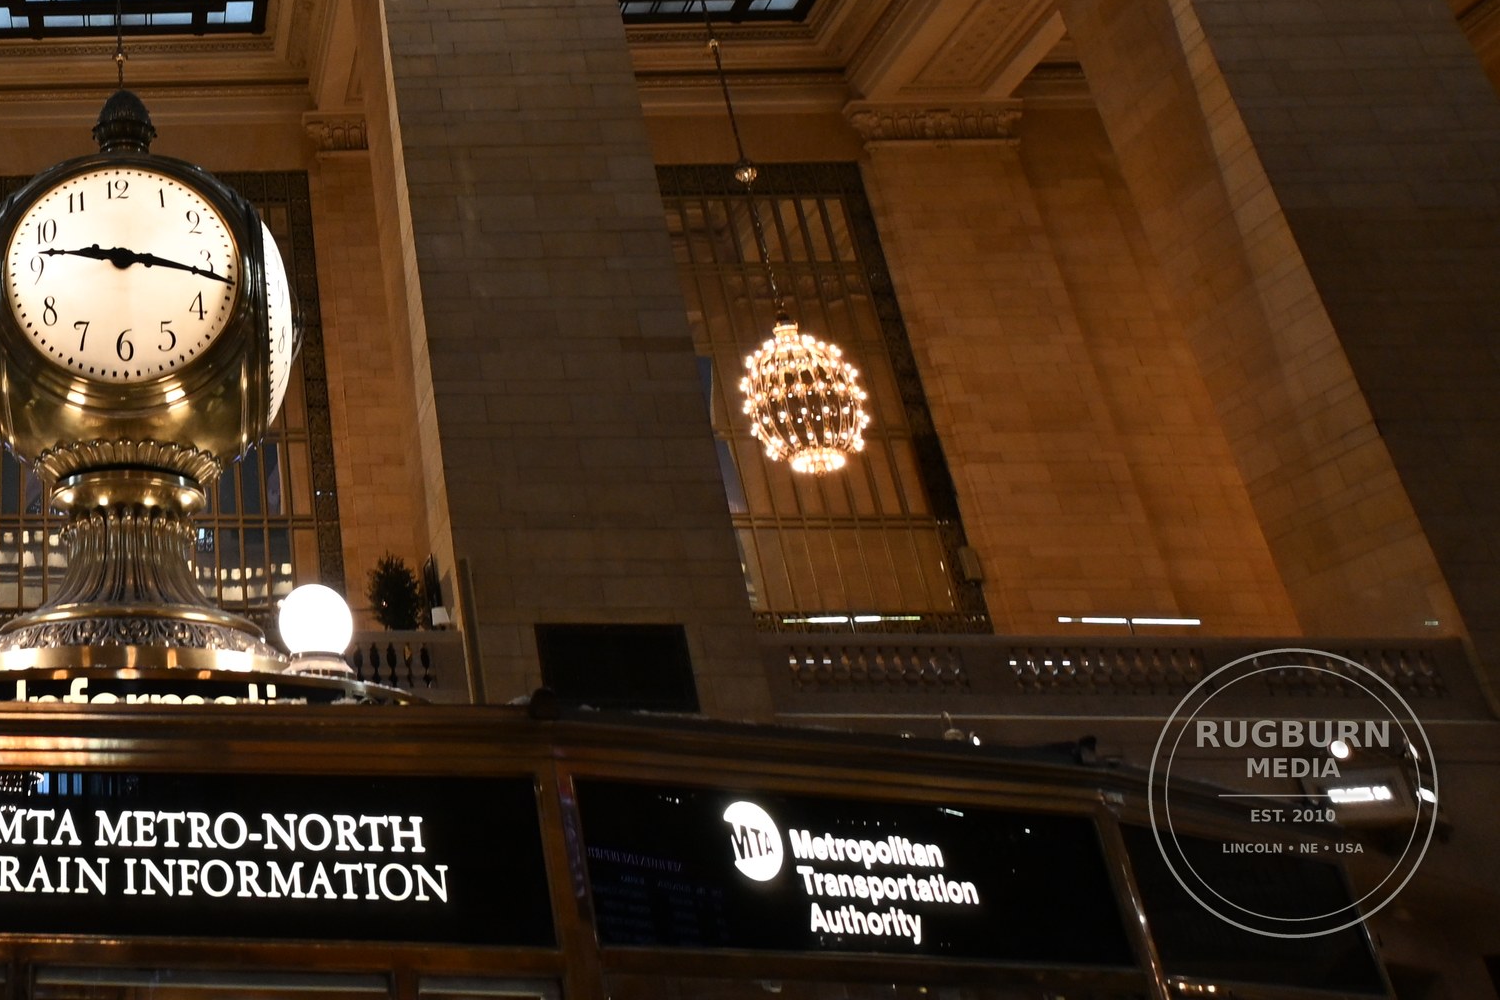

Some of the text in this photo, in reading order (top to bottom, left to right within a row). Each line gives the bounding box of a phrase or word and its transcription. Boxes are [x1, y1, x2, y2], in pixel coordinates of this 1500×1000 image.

[67, 191, 85, 213] 11
[106, 179, 129, 199] 12
[158, 188, 165, 208] 1
[37, 219, 57, 245] 10
[186, 210, 202, 234] 2
[30, 255, 45, 286] 9
[200, 249, 214, 274] 3
[43, 296, 57, 326] 8
[189, 290, 208, 320] 4
[73, 320, 90, 351] 7
[116, 329, 135, 361] 6
[158, 320, 177, 351] 5
[95, 811, 425, 853] METRO-NORTH
[731, 824, 775, 861] MTA
[789, 828, 945, 870] Metropolitan
[124, 859, 448, 902] INFORMATION
[797, 866, 980, 906] Transportation
[811, 903, 922, 945] Authority
